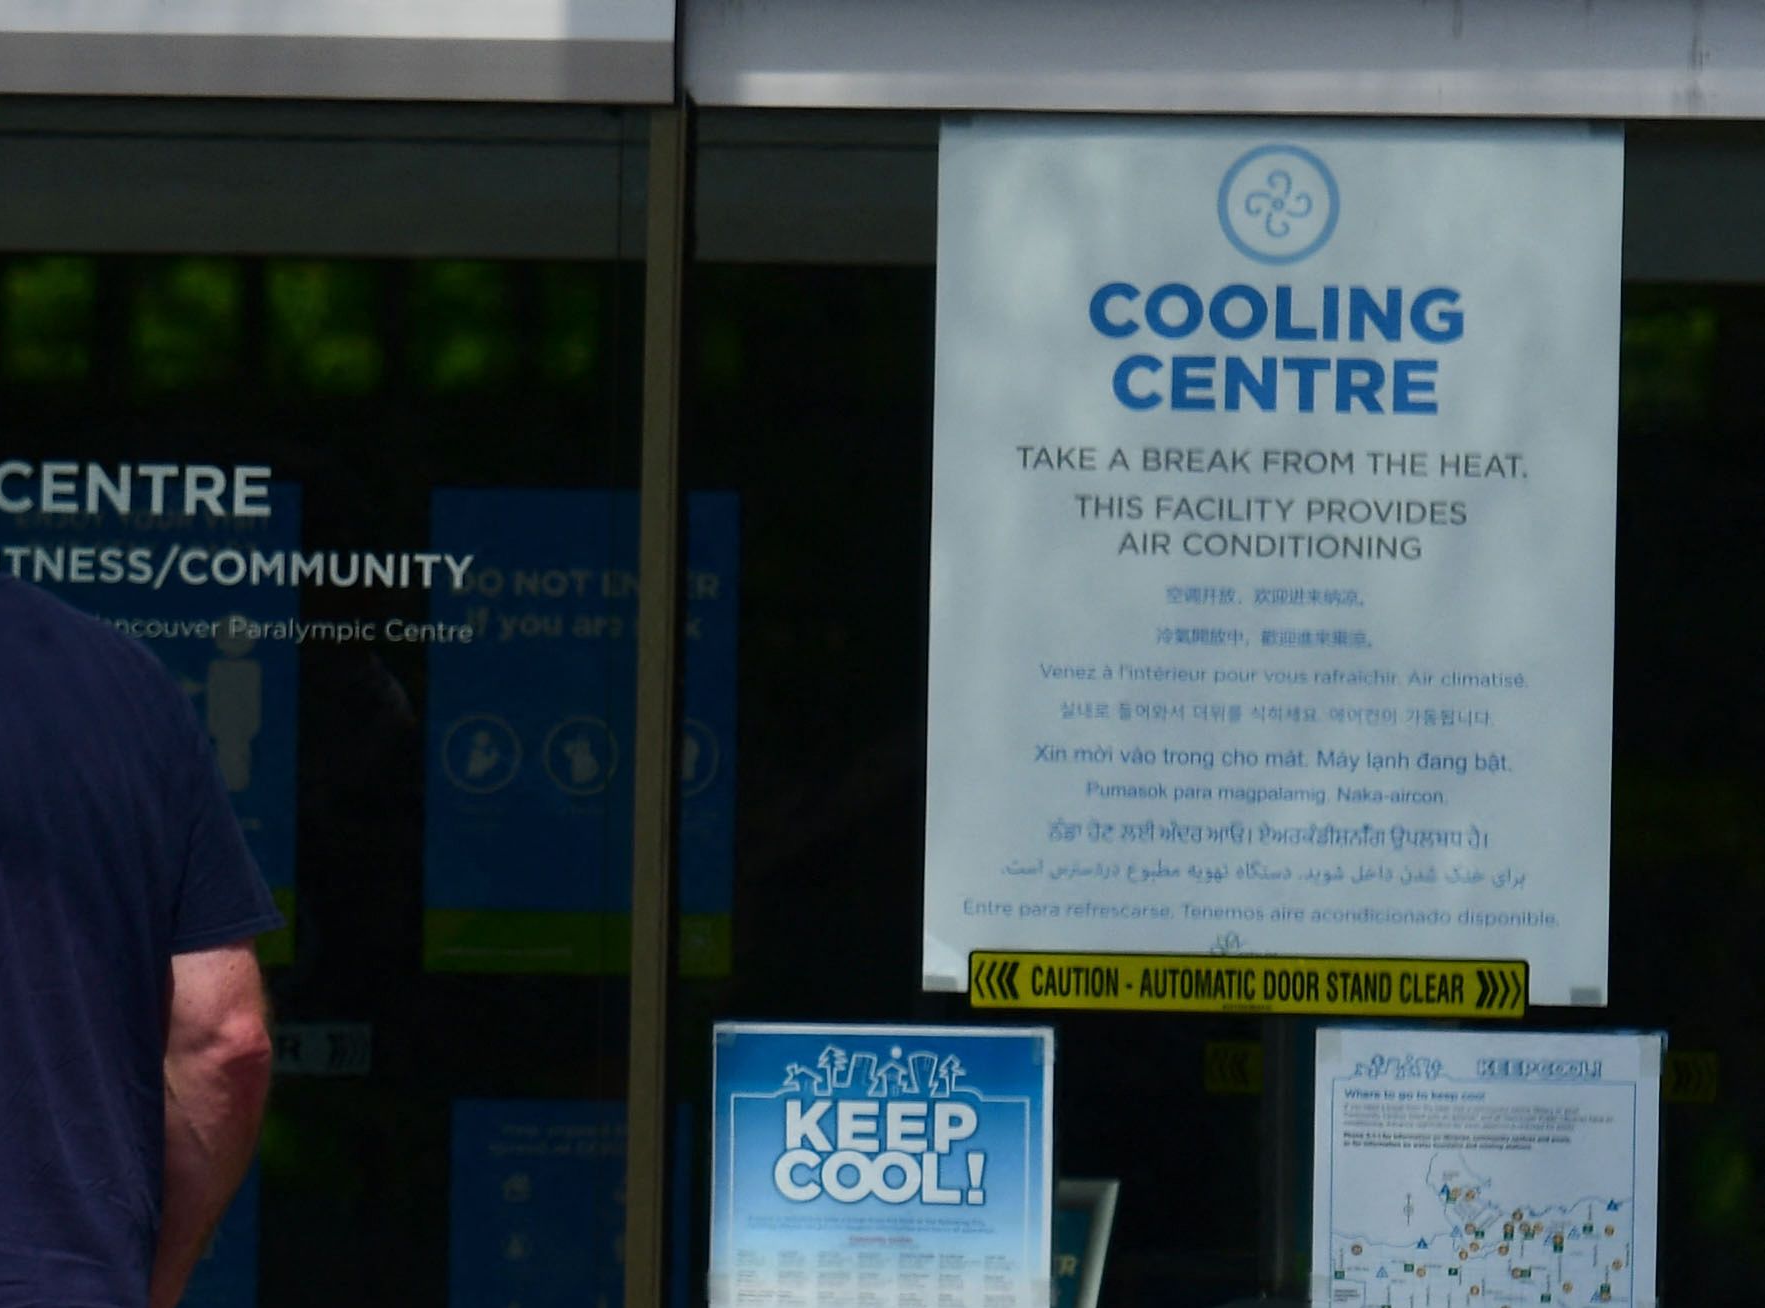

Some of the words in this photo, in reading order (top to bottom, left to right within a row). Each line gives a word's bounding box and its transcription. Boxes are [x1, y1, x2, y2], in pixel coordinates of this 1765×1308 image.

[1089, 282, 1465, 344] COOLING
[1113, 354, 1439, 415] CENTRE
[1016, 446, 1096, 473] TAKE
[1108, 448, 1129, 473] A
[1142, 449, 1251, 475] BREAK
[1263, 450, 1355, 477] FROM
[1366, 453, 1428, 478] THE
[1440, 454, 1529, 480] HEAT.
[1075, 494, 1143, 521] THIS
[1156, 495, 1295, 523] FACILITY
[1307, 498, 1467, 527] PROVIDES
[1117, 532, 1172, 556] AIR
[1183, 533, 1423, 562] CONDITIONING
[229, 616, 377, 644] Paralympic
[385, 618, 475, 644] Centre
[1040, 663, 1096, 681] Venez
[1213, 667, 1256, 685] pour
[1264, 670, 1307, 685] vous
[1407, 670, 1435, 687] Air
[1035, 744, 1067, 763] Xin
[1163, 747, 1214, 771] trong
[1221, 748, 1258, 767] cho
[1086, 780, 1167, 800] Pumasok
[1174, 784, 1212, 802] para
[964, 897, 1013, 917] Entre
[1020, 902, 1060, 920] para
[1184, 903, 1264, 922] Tenemos
[1270, 905, 1304, 923] aire
[1311, 907, 1452, 926] acondicionado
[1031, 965, 1118, 998] CAUTION
[1140, 968, 1256, 1001] AUTOMATIC
[1264, 970, 1319, 1002] DOOR
[1327, 971, 1391, 1003] STAND
[1399, 973, 1464, 1005] CLEAR
[785, 1099, 978, 1154] KEEP
[774, 1149, 985, 1205] COOL!
